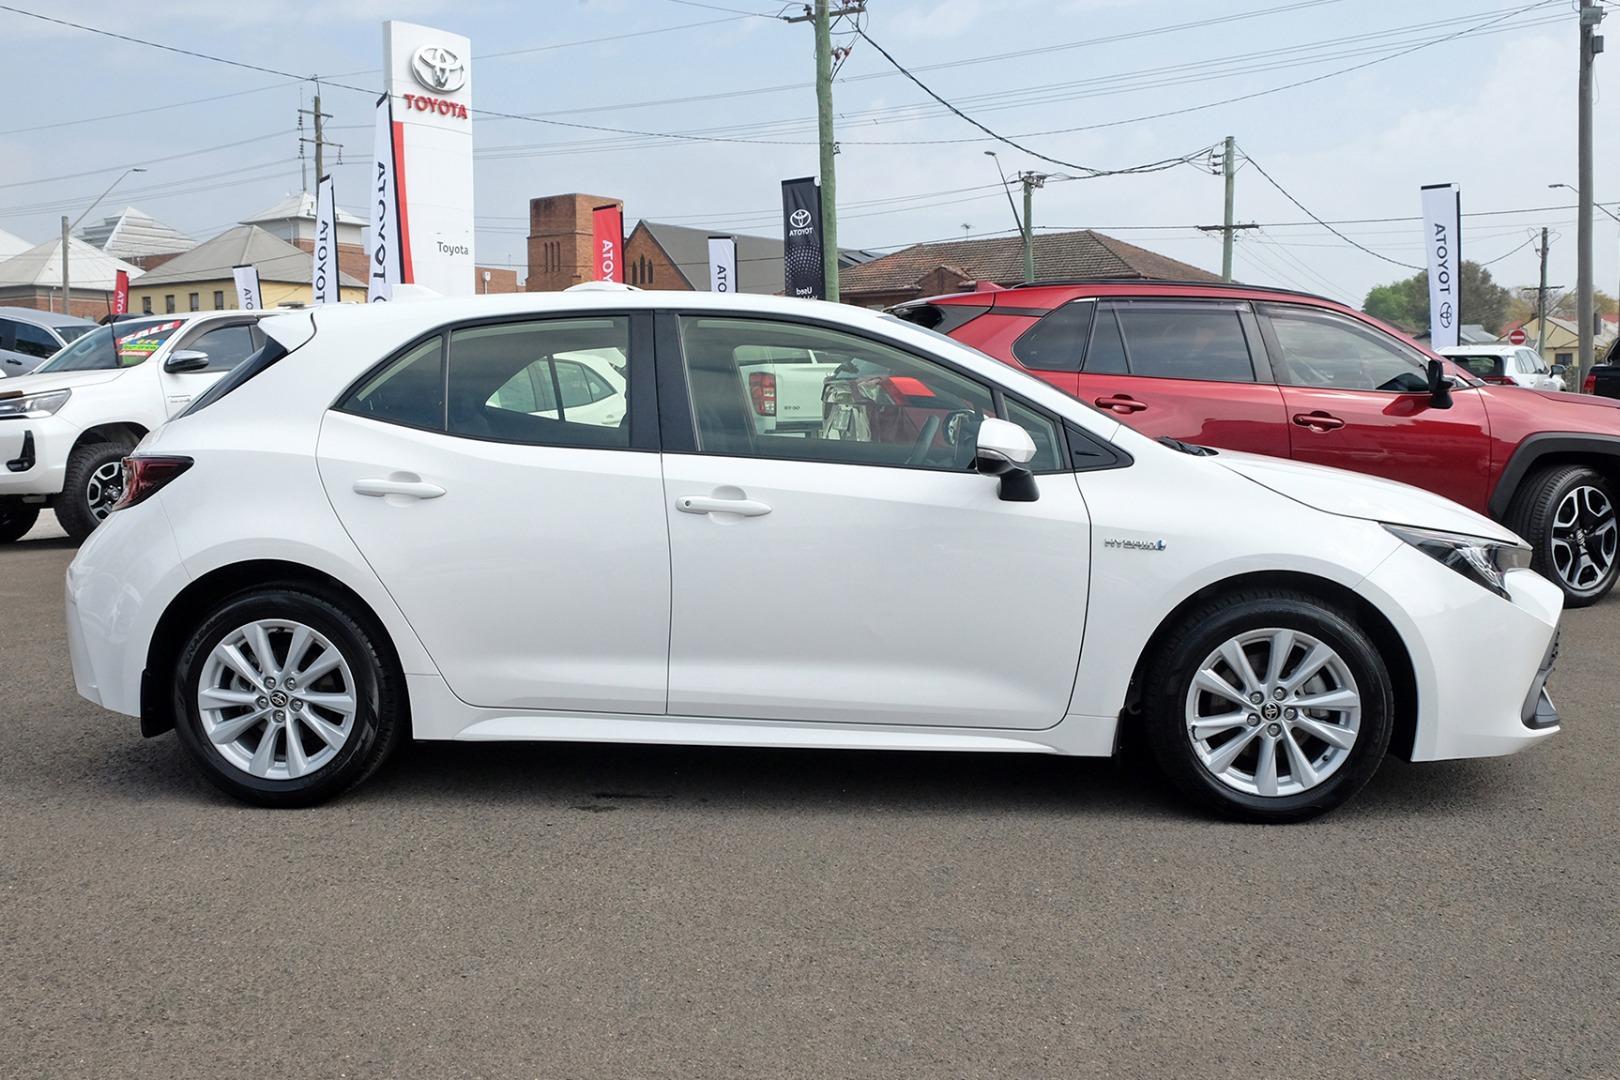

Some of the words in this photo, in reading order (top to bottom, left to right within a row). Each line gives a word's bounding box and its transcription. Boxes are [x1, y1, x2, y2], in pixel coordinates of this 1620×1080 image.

[403, 93, 469, 120] TOYOTA
[436, 241, 469, 256] Toyota
[1103, 538, 1157, 551] HYBRID
